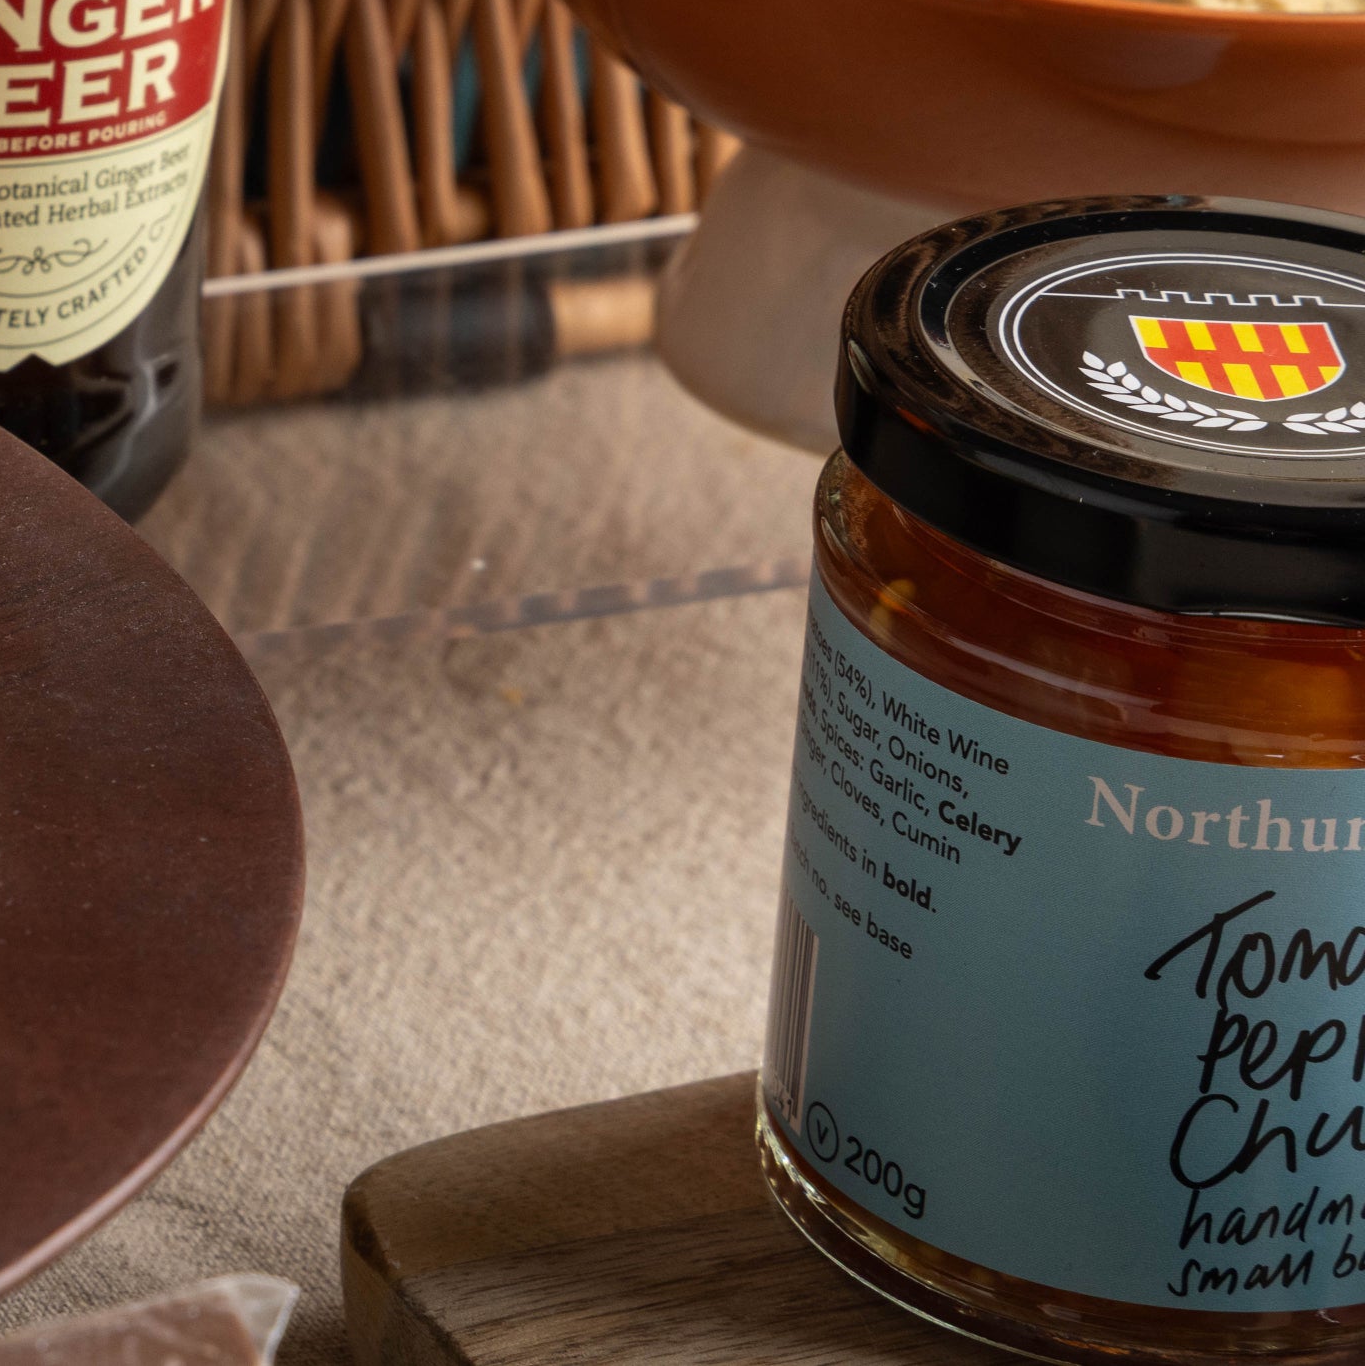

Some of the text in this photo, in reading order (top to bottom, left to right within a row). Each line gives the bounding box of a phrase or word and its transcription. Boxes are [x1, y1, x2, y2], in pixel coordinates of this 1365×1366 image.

[88, 111, 168, 145] POURING
[94, 157, 157, 193] Ginger
[160, 143, 190, 172] Beer
[47, 194, 121, 227] Herbal
[124, 171, 190, 209] Extracts
[57, 245, 148, 320] CRAFTED
[834, 650, 876, 711] (54%),
[882, 691, 940, 746] White
[948, 726, 1010, 777] Wine
[837, 691, 881, 751] Sugar,
[888, 735, 969, 798] Onions,
[820, 709, 1022, 857] Spices: Garlic, Celery
[831, 760, 884, 826] Cloves,
[892, 812, 961, 865] Cumin
[812, 868, 829, 901] no.
[834, 893, 861, 927] see
[866, 911, 913, 960] base
[861, 848, 877, 879] in
[882, 861, 937, 914] bold.
[844, 1135, 927, 1220] 200g
[1168, 1250, 1314, 1297] small
